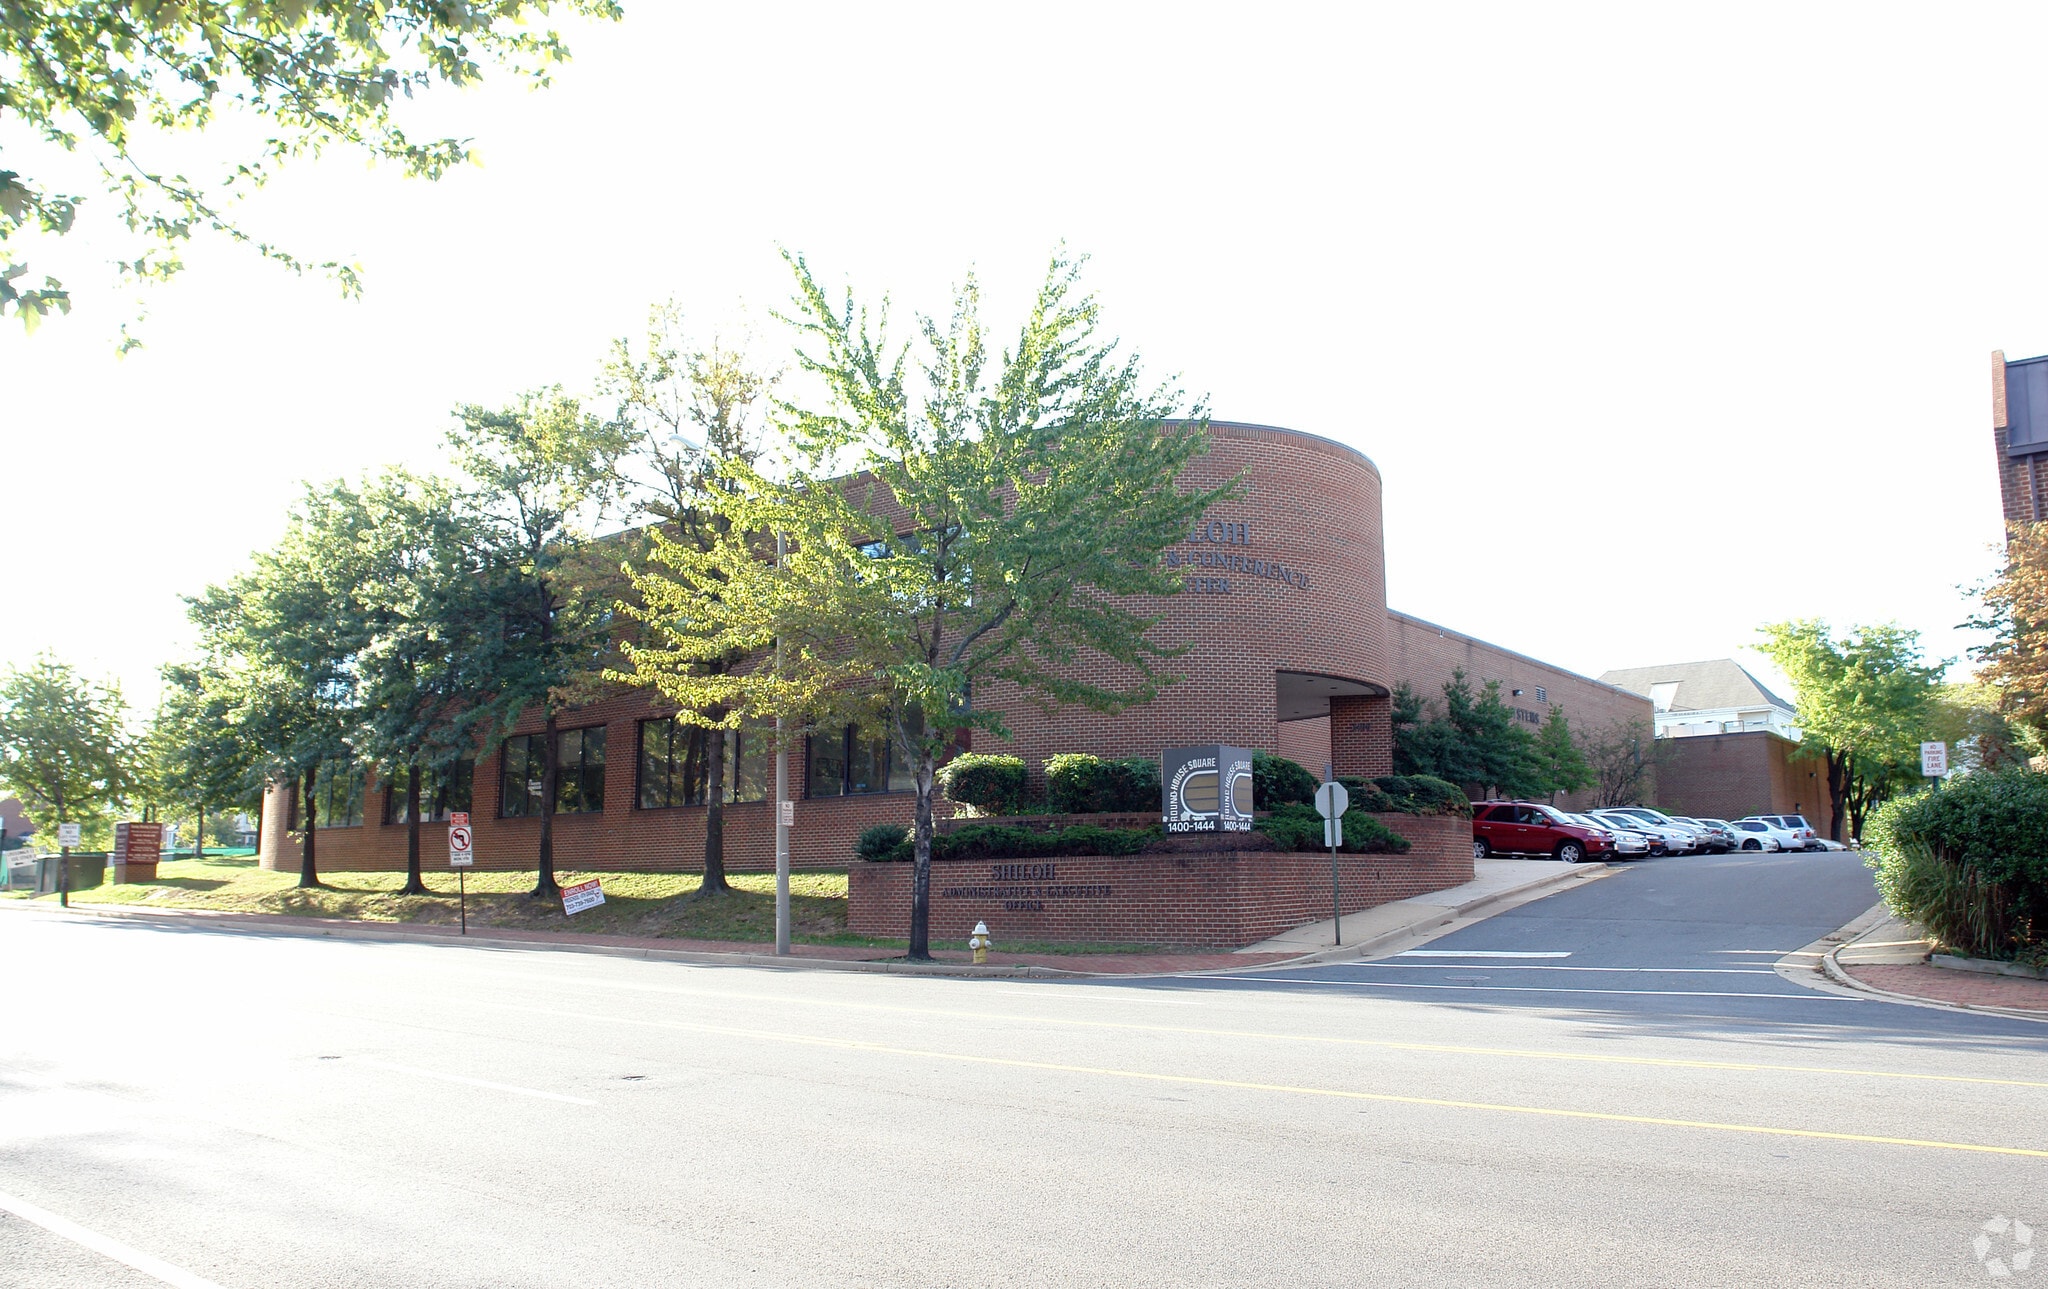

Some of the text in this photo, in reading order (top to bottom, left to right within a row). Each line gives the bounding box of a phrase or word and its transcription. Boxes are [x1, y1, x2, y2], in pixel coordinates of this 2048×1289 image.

[1167, 551, 1309, 590] & CONFERENCE
[1170, 764, 1189, 791] HOUSE
[1187, 758, 1216, 770] SQUARE
[1168, 821, 1215, 832] 1400-1444
[1224, 821, 1251, 831] 1400-1444
[991, 864, 1056, 881] SHILOH
[942, 885, 1112, 897] ADMINISTRATIVE & EXECUTIVE
[1004, 899, 1043, 911] OFFICE
